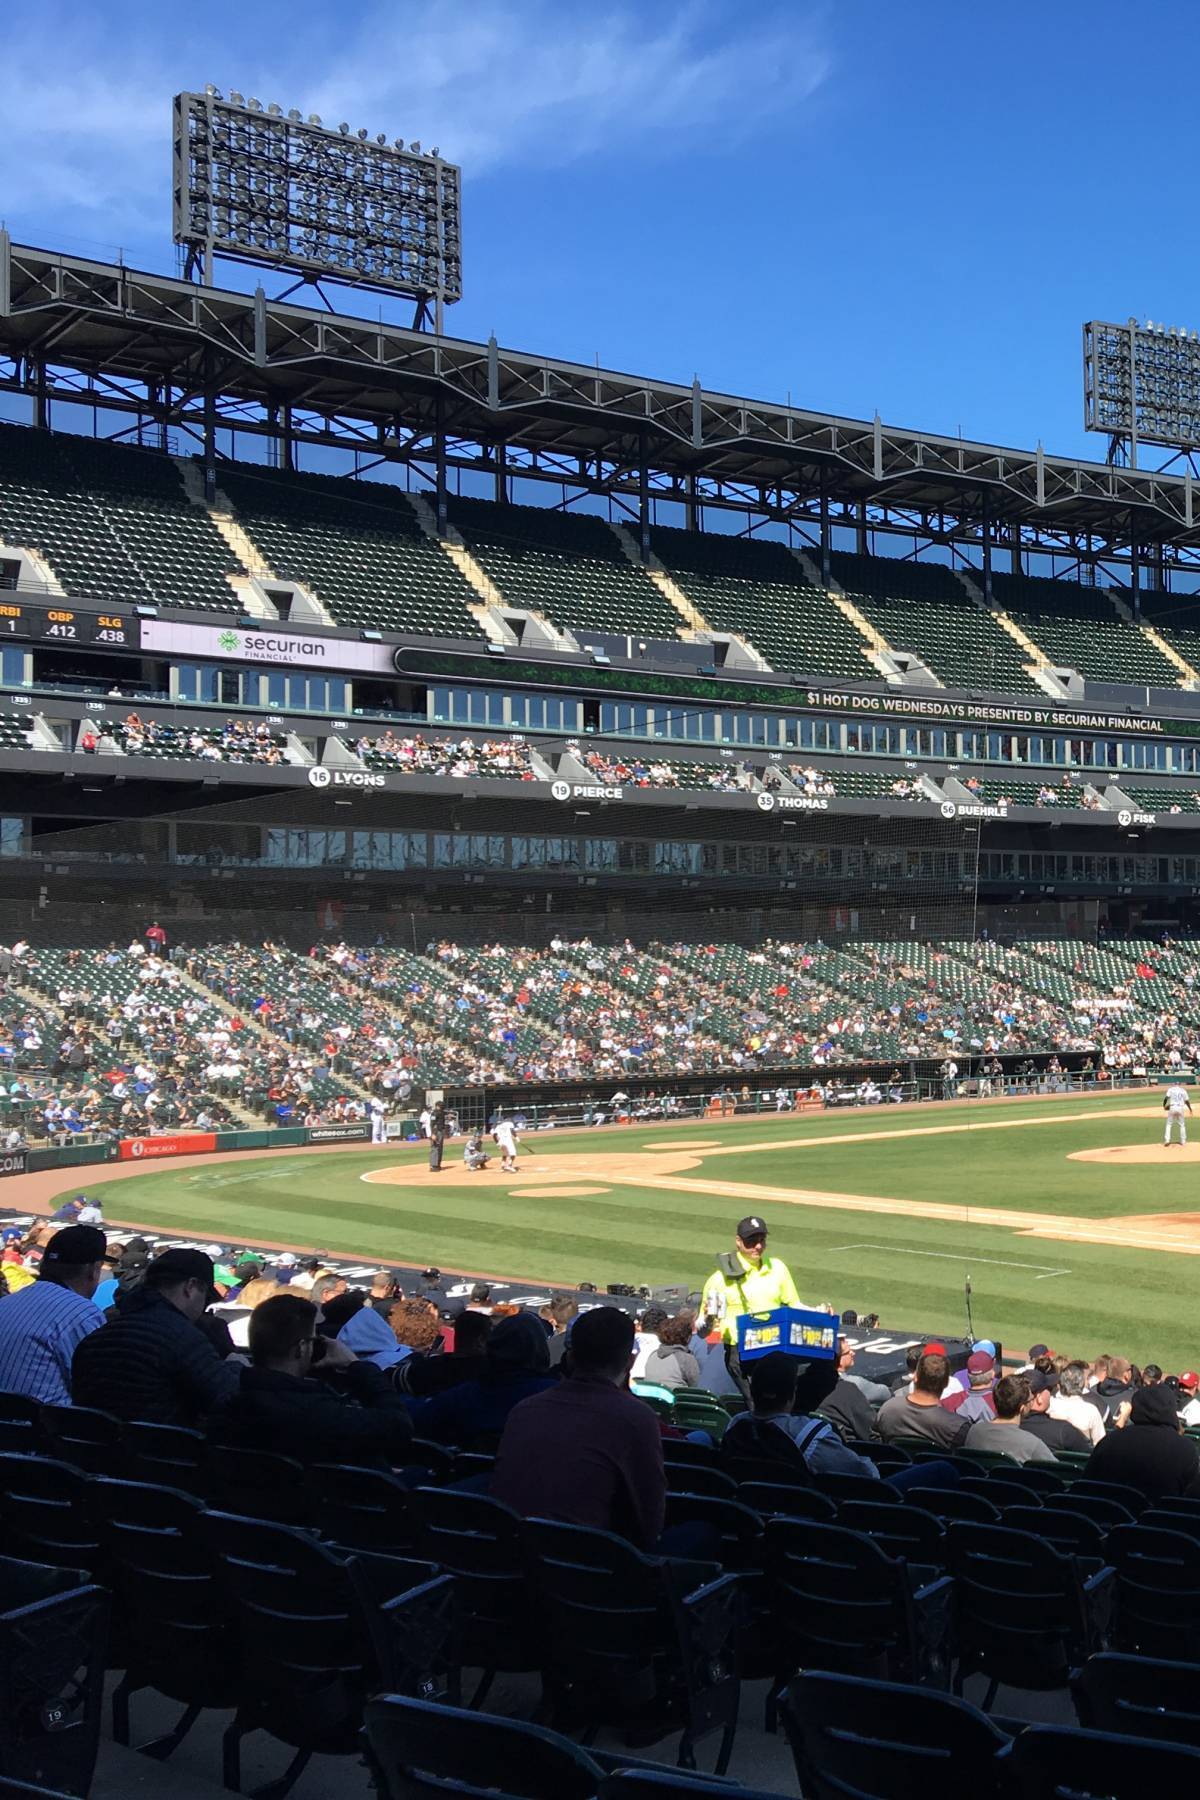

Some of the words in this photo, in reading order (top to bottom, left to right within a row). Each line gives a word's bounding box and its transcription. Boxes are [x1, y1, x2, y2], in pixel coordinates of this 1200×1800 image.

[0, 605, 21, 617] RBI
[48, 611, 74, 622] OBP
[8, 620, 15, 631] 1
[98, 617, 122, 628] SLG
[46, 625, 76, 638] .412
[96, 630, 125, 642] .438
[244, 636, 325, 656] securian
[245, 651, 293, 661] FINANCIAL
[807, 692, 820, 705] $1
[823, 694, 849, 707] HOT
[852, 696, 879, 709] DOG
[882, 699, 964, 716] WEDNESDAYS
[967, 706, 1032, 722] PRESENTED
[1034, 712, 1050, 723] BY
[1052, 714, 1106, 727] SECURIAN
[1108, 717, 1163, 732] FINANCIAL
[313, 771, 326, 782] 16
[335, 772, 385, 786] LYONS
[556, 785, 567, 796] 19
[574, 786, 623, 799] PIERCE
[760, 796, 772, 806] 35
[778, 796, 828, 809] THOMAS
[942, 805, 954, 814] 56
[958, 805, 1008, 817] BUEHRLE
[1120, 814, 1130, 823] 72
[1134, 814, 1155, 824] FISK
[311, 1128, 364, 1138] whitesox.com
[48, 1710, 62, 1722] 19
